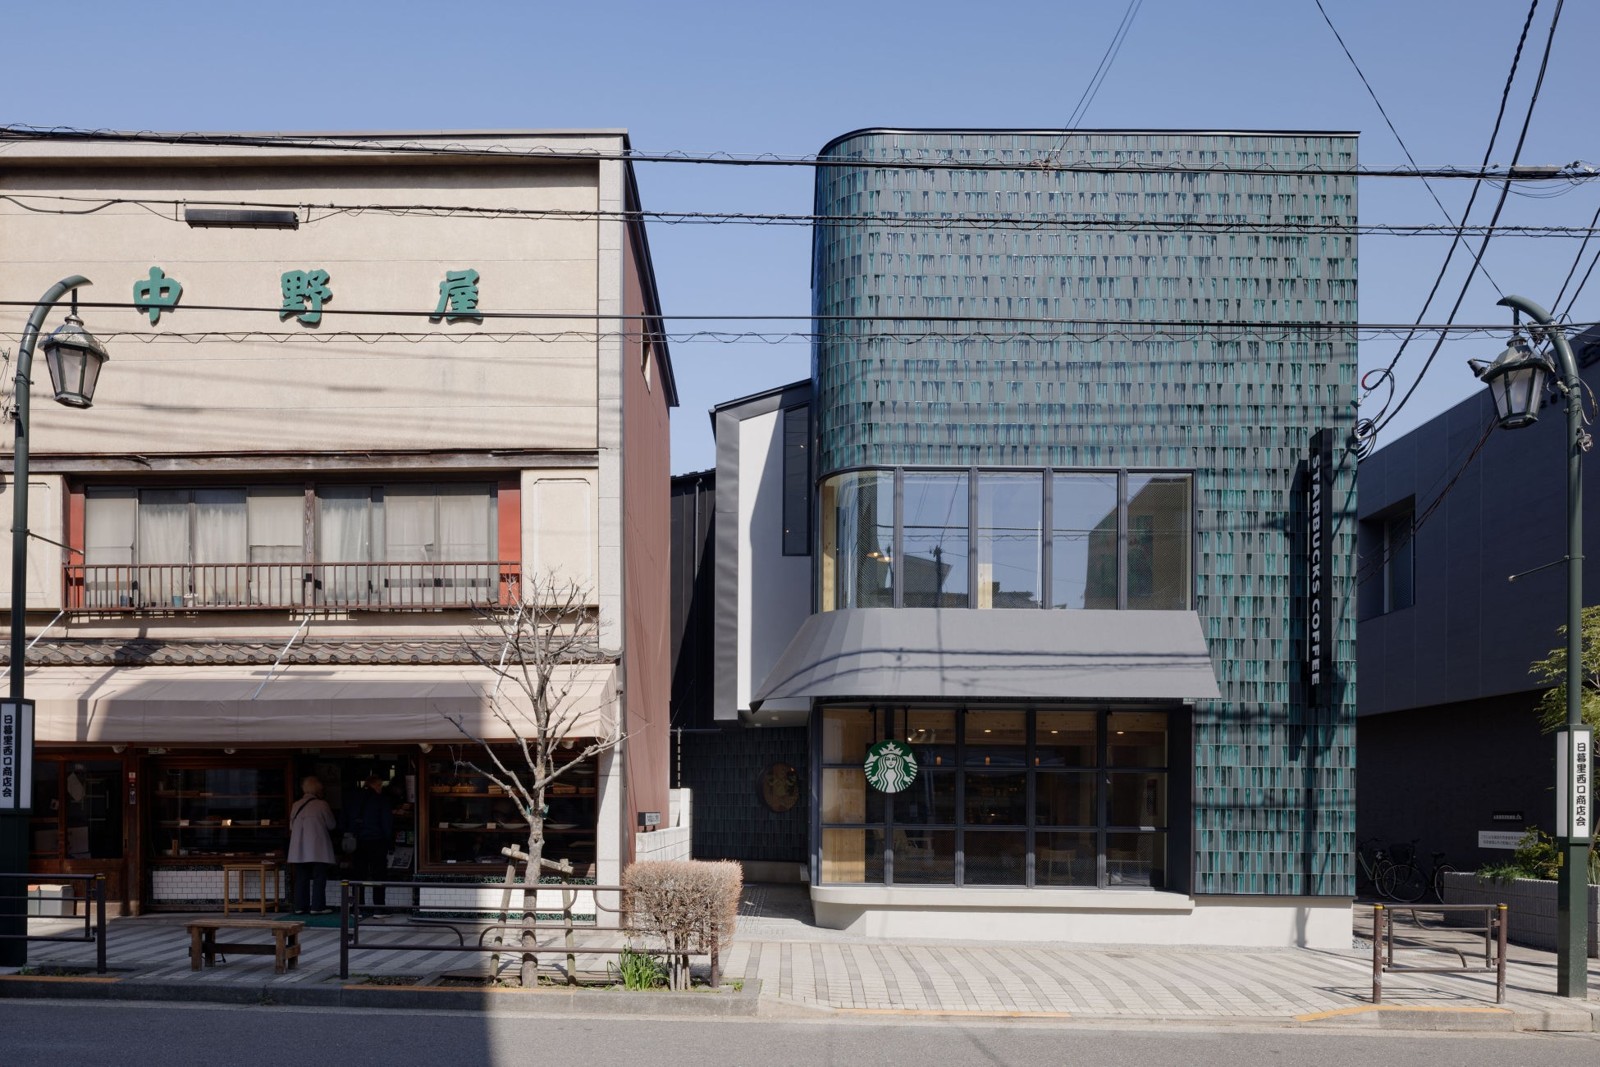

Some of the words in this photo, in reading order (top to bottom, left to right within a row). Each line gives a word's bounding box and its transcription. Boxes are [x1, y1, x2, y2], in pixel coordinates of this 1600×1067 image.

[133, 266, 484, 327] 中野屋
[1311, 454, 1320, 594] STARBUCKS
[1311, 601, 1320, 686] COFFEE
[2, 714, 12, 797] 日暮里西口商店会
[1576, 742, 1586, 826] 日暮里西口商店会
